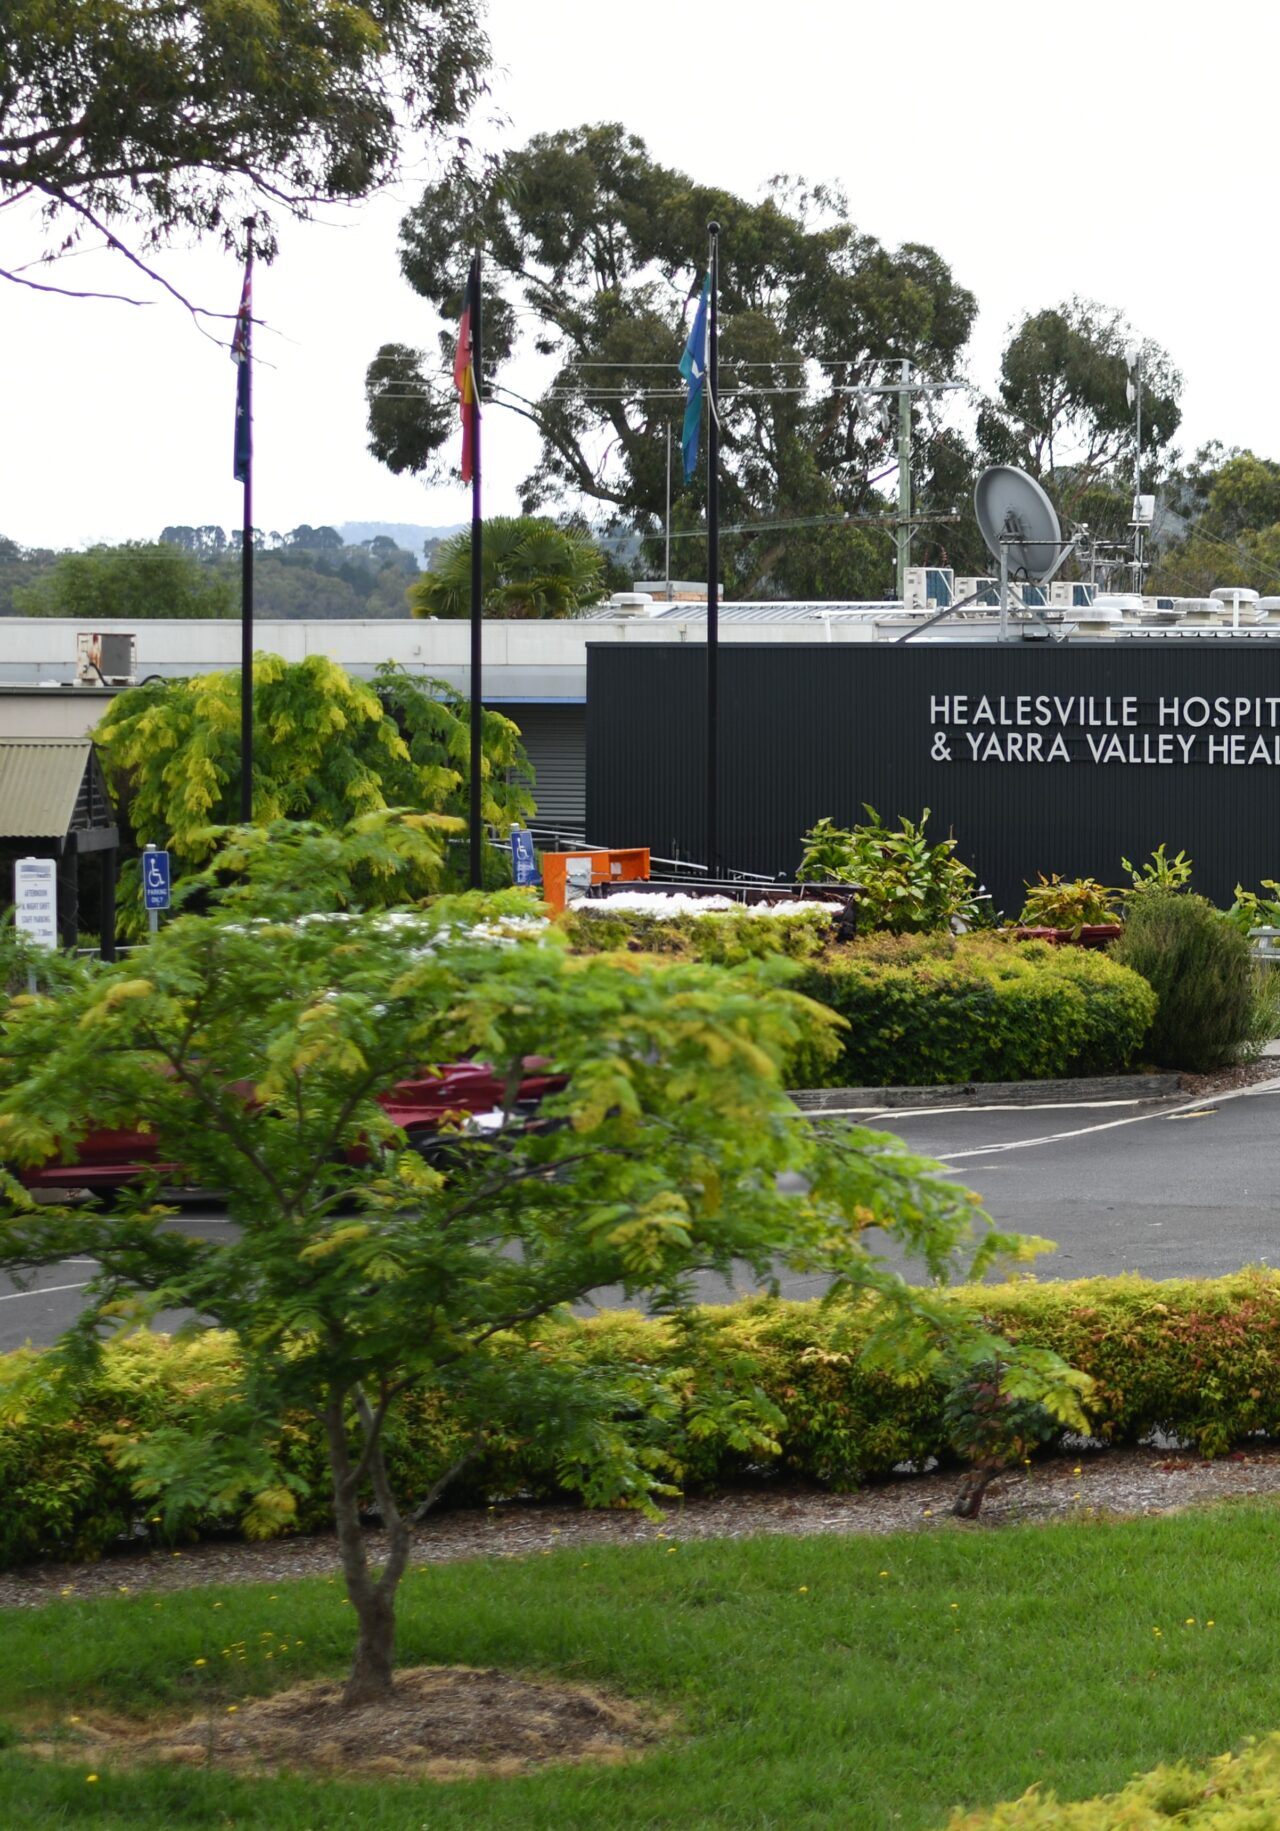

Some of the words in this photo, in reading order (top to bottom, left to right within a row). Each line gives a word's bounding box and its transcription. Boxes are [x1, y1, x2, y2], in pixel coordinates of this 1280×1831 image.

[930, 694, 1138, 726] HEALESVILLE
[930, 731, 952, 761] &
[965, 731, 1071, 763] YARRA
[1085, 733, 1197, 764] VALLEY
